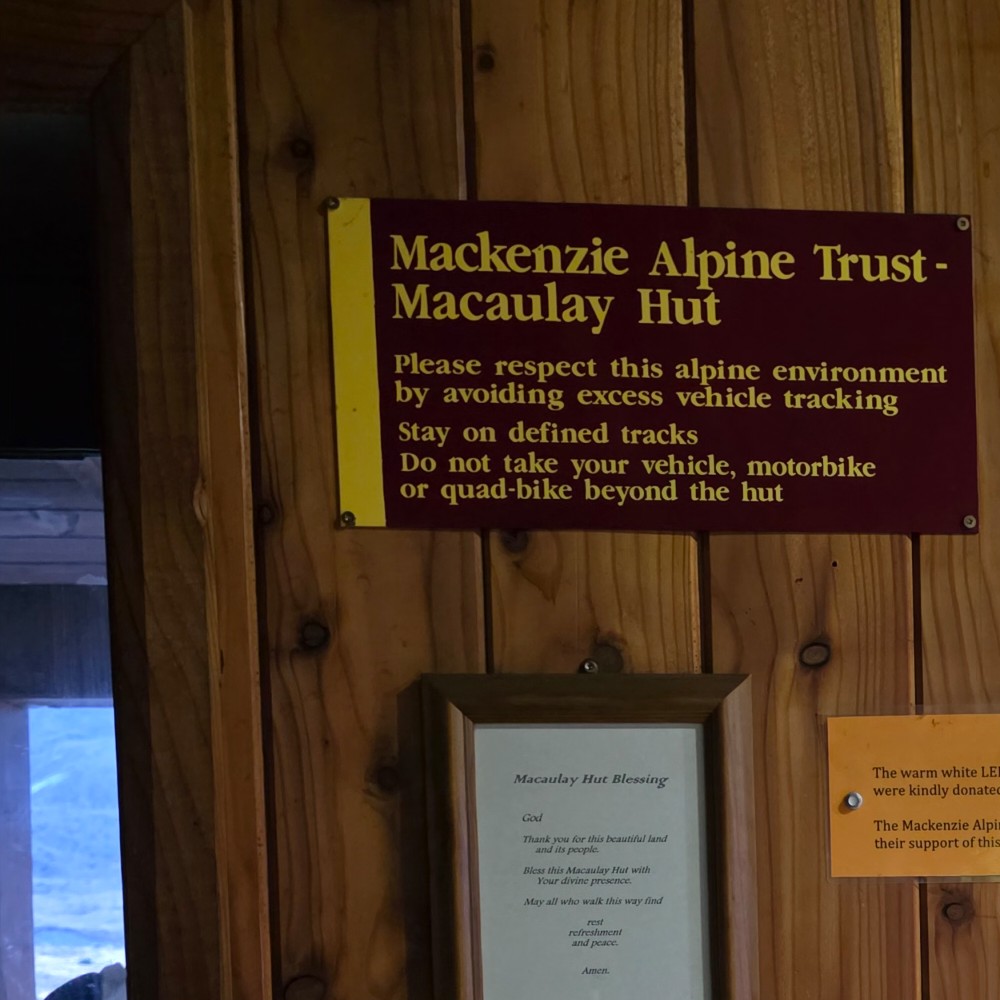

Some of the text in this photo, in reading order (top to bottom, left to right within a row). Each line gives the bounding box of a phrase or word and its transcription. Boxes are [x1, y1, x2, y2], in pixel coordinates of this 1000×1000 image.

[390, 231, 927, 290] Mackenzie Alpine Trust
[392, 282, 721, 334] Macaulay Hut
[394, 352, 947, 385] Please respect this alpine environment
[395, 380, 898, 416] by avoiding excess vehicle tracking
[399, 421, 698, 447] Stay on defined tracks
[400, 452, 876, 479] Do not take your vehicle, motorbike
[400, 478, 783, 506] or quad-bike beyond the hut
[514, 773, 669, 789] Macaulay Hut Blessing
[873, 788, 905, 796] were
[909, 784, 949, 799] kindly
[522, 813, 543, 822] God
[523, 835, 551, 843] Thank
[572, 835, 586, 843] for
[606, 834, 646, 842] beautiful
[648, 834, 668, 842] land
